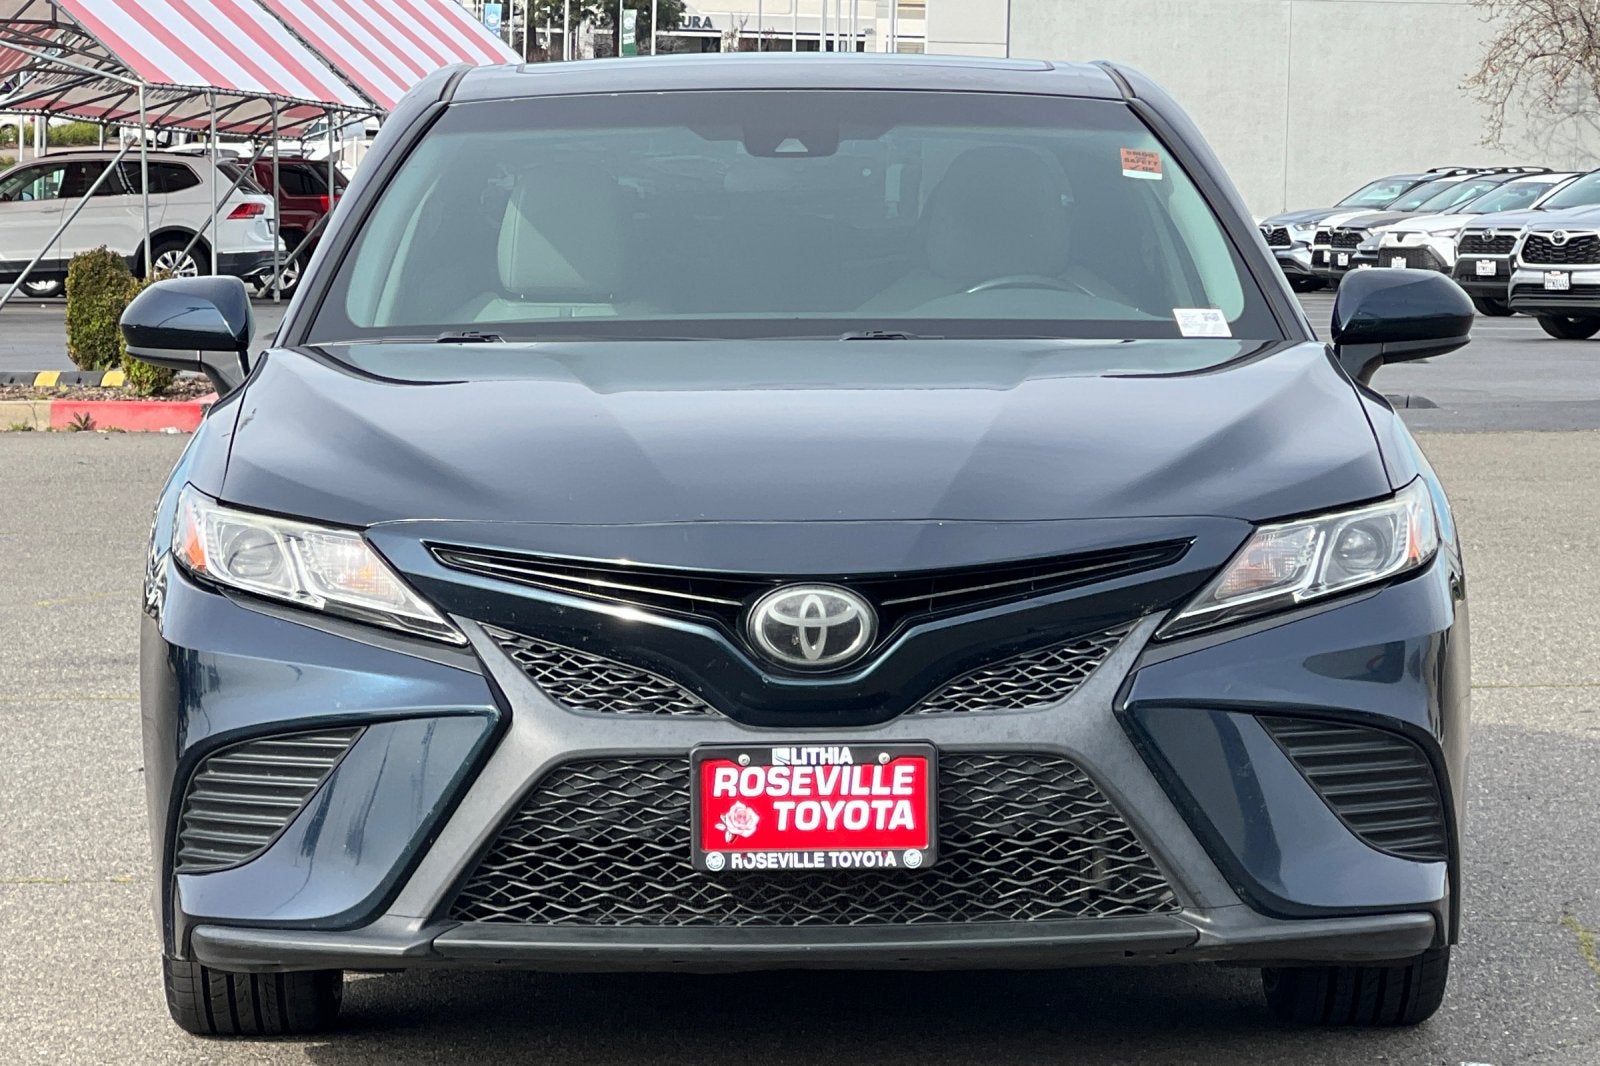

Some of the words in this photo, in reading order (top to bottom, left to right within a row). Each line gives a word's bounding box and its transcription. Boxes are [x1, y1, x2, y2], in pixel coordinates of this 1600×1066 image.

[681, 15, 713, 29] URA
[791, 746, 854, 765] LITHIA
[713, 765, 915, 798] ROSEVILLE
[772, 800, 915, 831] TOYOTA
[731, 851, 825, 869] ROSEVILLE
[829, 851, 897, 867] TOYOTA
